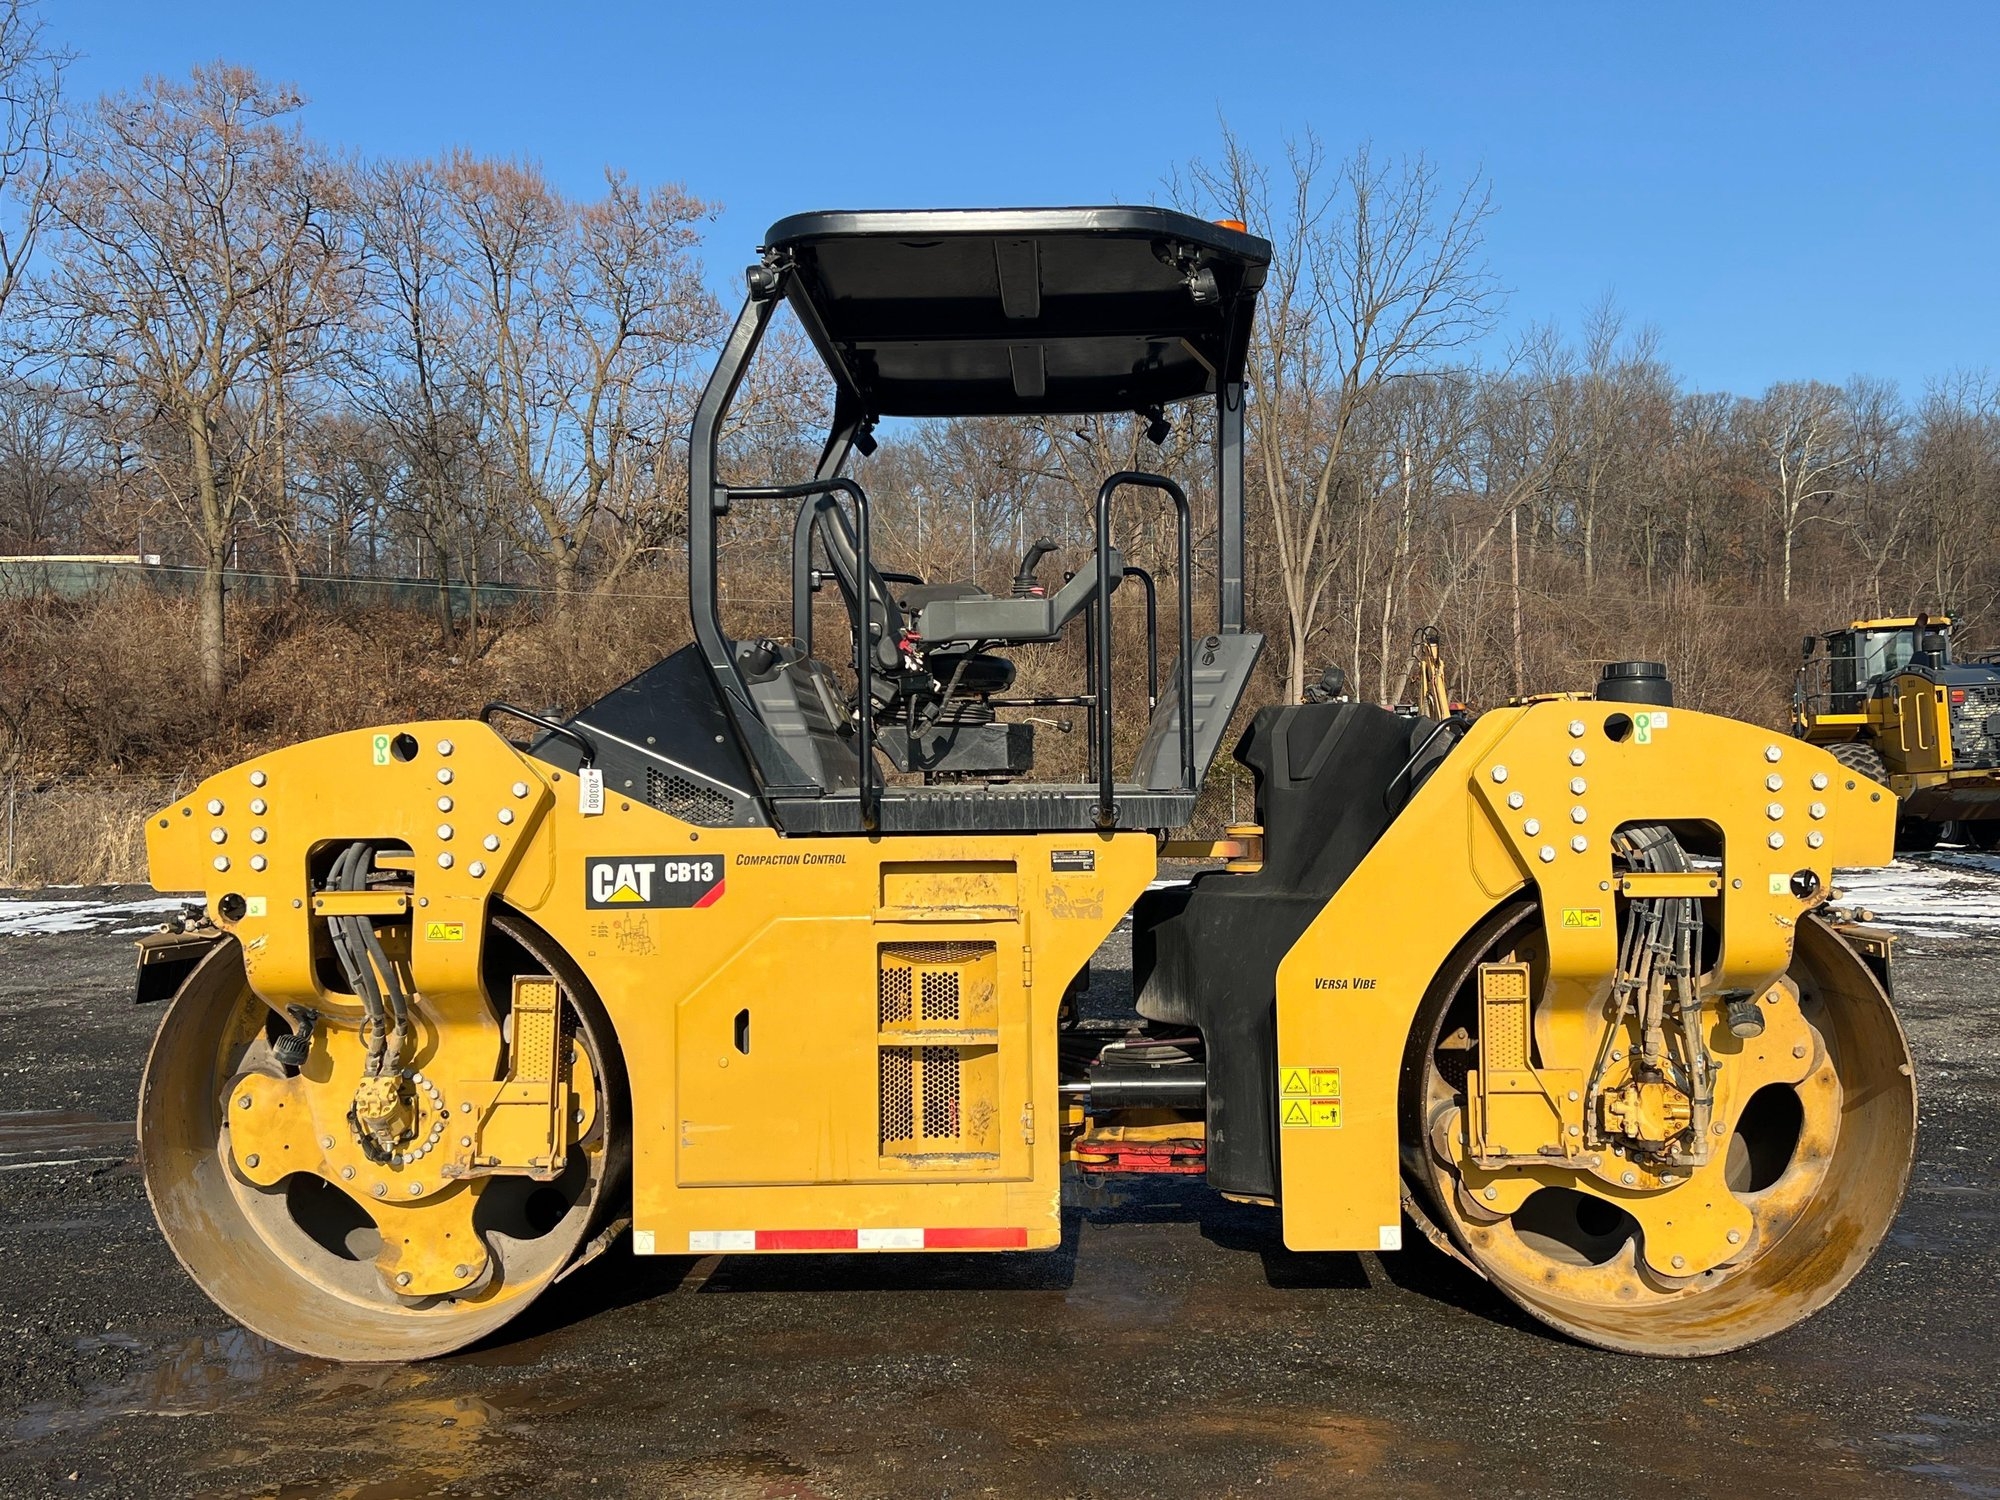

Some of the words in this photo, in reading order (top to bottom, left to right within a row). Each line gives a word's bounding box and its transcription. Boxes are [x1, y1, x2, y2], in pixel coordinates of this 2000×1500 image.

[589, 778, 600, 808] 203080
[736, 854, 800, 866] COMPACTION
[803, 853, 847, 865] CONTROL
[592, 863, 656, 903] CAT
[664, 862, 714, 883] CB13
[1315, 978, 1348, 989] VERSA
[1353, 978, 1377, 989] VIBE
